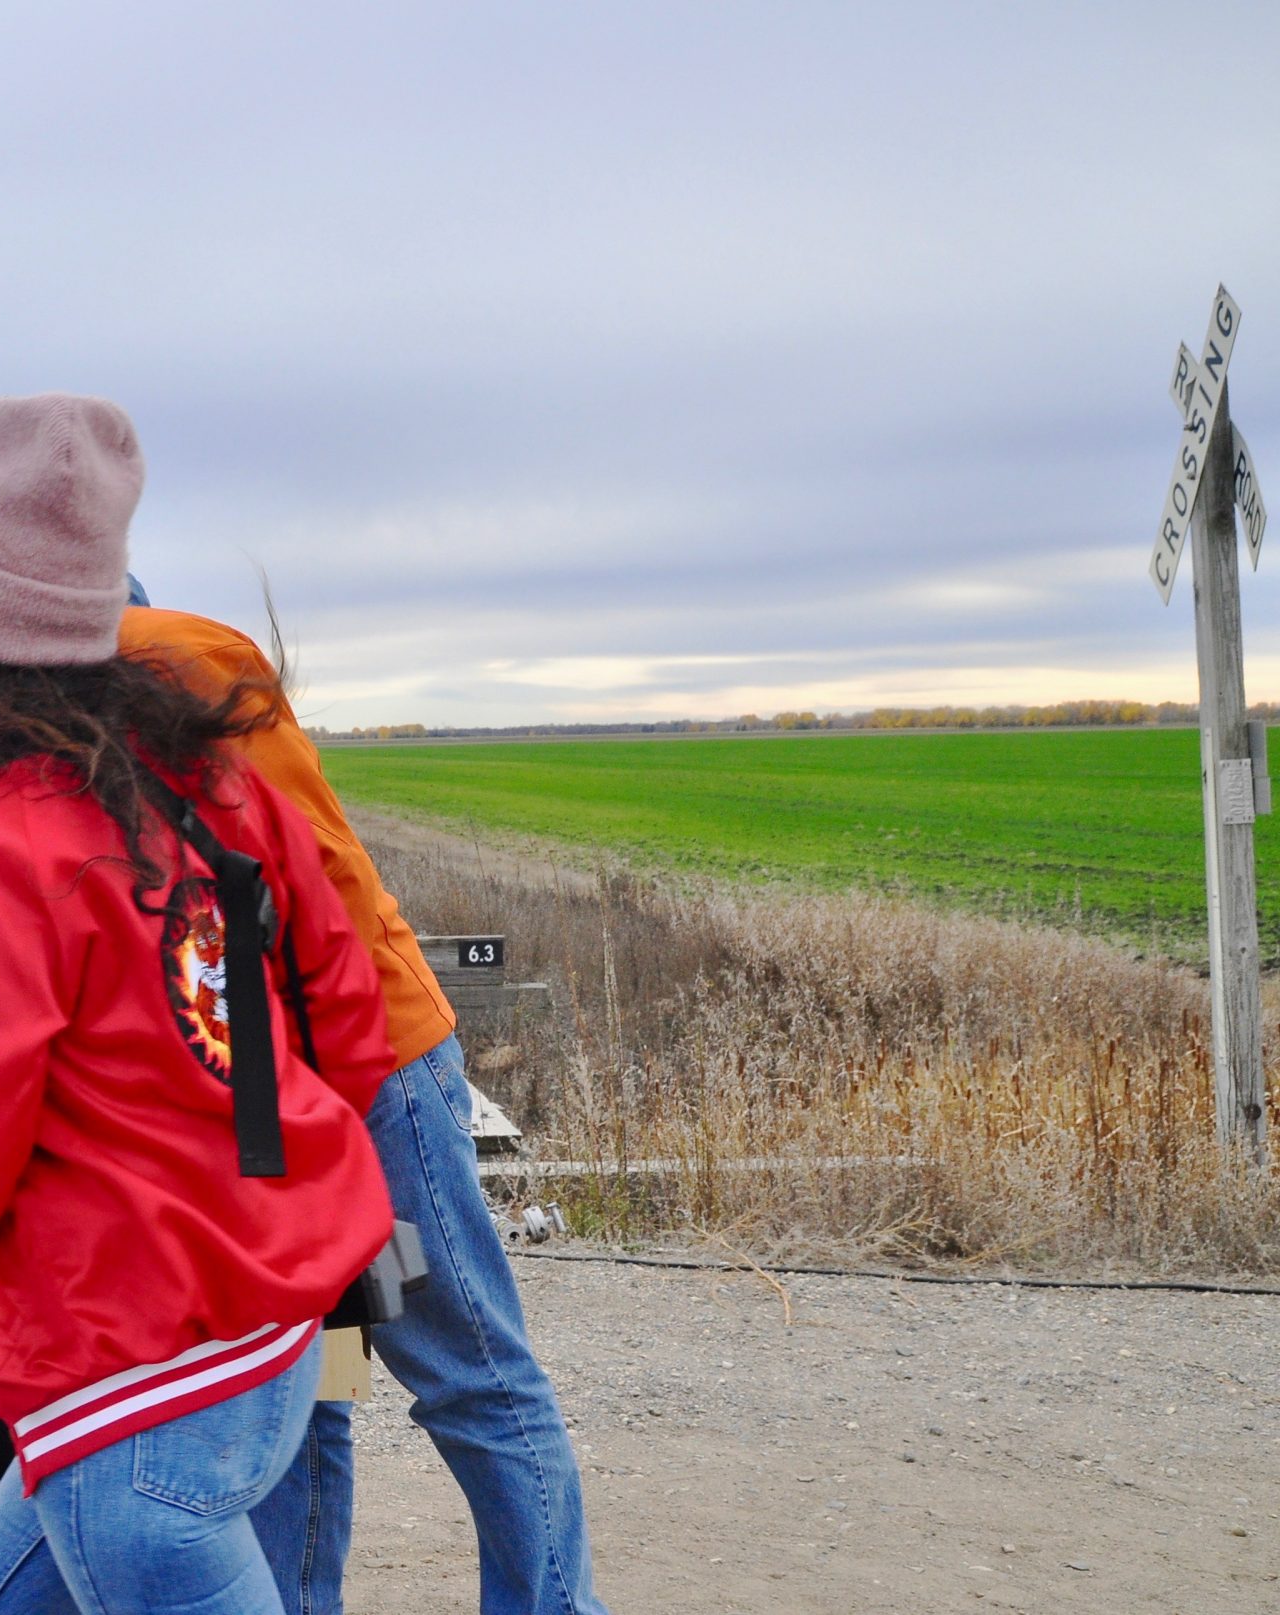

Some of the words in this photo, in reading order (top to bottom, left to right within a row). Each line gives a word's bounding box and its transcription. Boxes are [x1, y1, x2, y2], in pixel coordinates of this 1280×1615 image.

[1155, 300, 1233, 587] CROSSING
[1234, 449, 1261, 549] ROAD
[468, 944, 494, 963] 6.3
